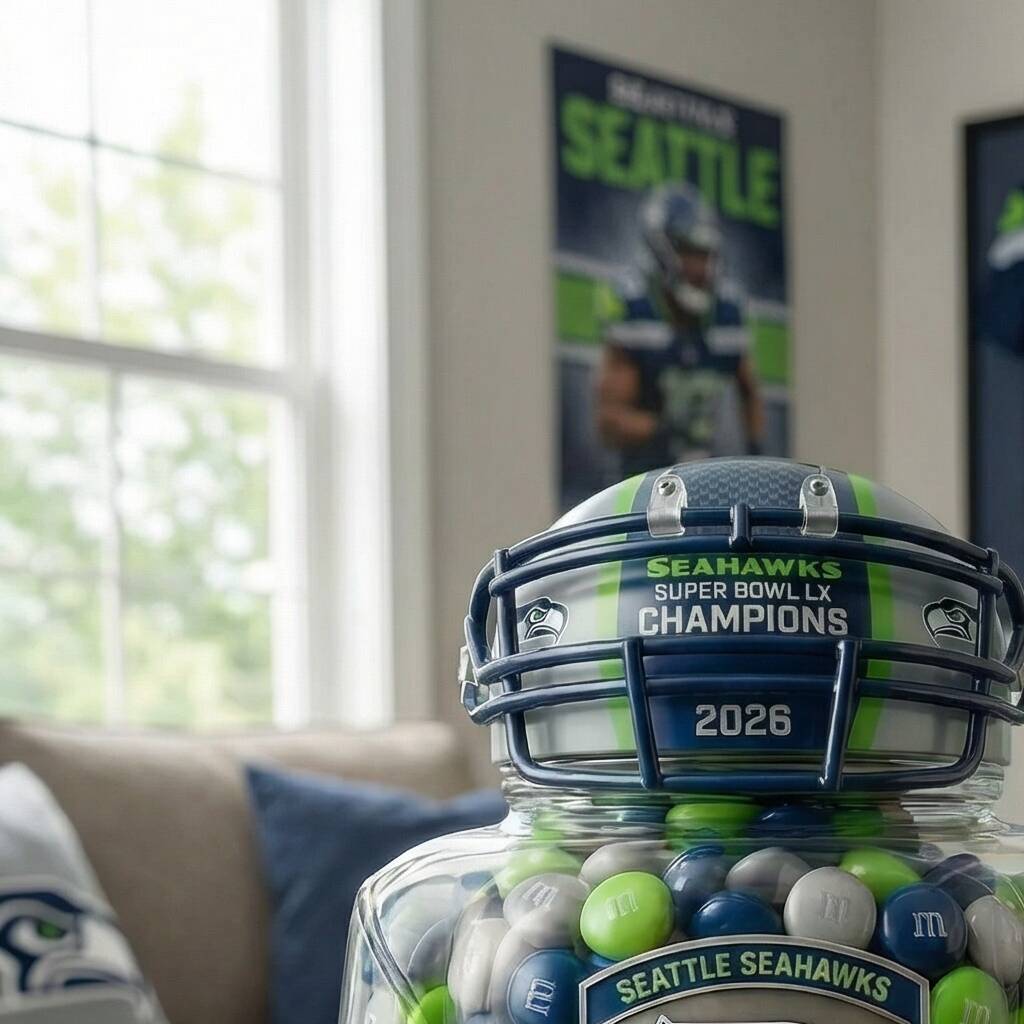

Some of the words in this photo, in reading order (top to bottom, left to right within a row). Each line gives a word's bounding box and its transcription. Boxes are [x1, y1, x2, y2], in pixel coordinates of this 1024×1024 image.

[560, 95, 780, 229] SEATTLE
[647, 557, 842, 579] SEAHAWKS
[655, 581, 727, 601] SUPER
[734, 581, 800, 600] BOWL
[805, 583, 832, 602] LX
[638, 604, 849, 636] CHAMPIONS
[695, 703, 792, 737] 2026
[912, 911, 949, 939] m
[616, 952, 733, 1005] SEATTLE
[740, 951, 893, 1003] SEAHAWKS
